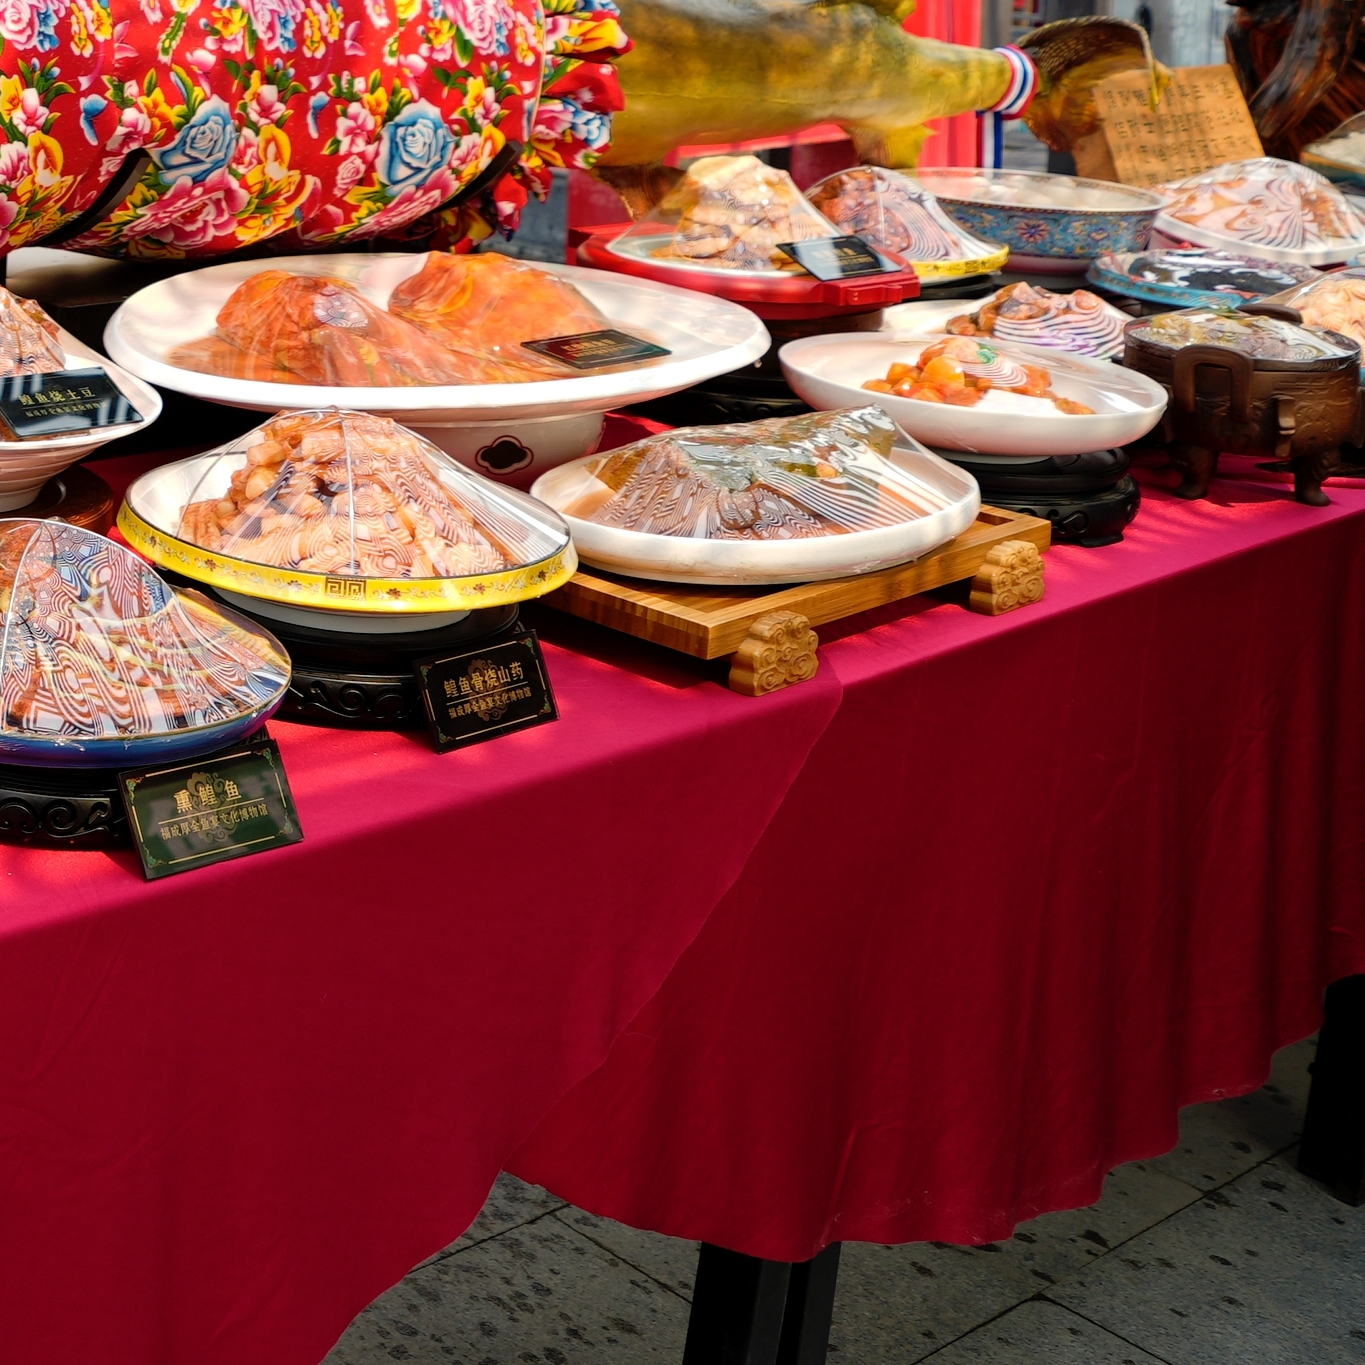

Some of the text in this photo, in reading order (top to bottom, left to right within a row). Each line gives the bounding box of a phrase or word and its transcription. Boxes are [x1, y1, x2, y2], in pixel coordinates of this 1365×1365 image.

[18, 386, 96, 406] 鳇鱼烧土豆
[443, 660, 525, 699] 鳇鱼骨烧山药
[172, 779, 242, 814] 熏鳇鱼
[159, 802, 269, 841] 福成厚全鱼宴文化博物馆
